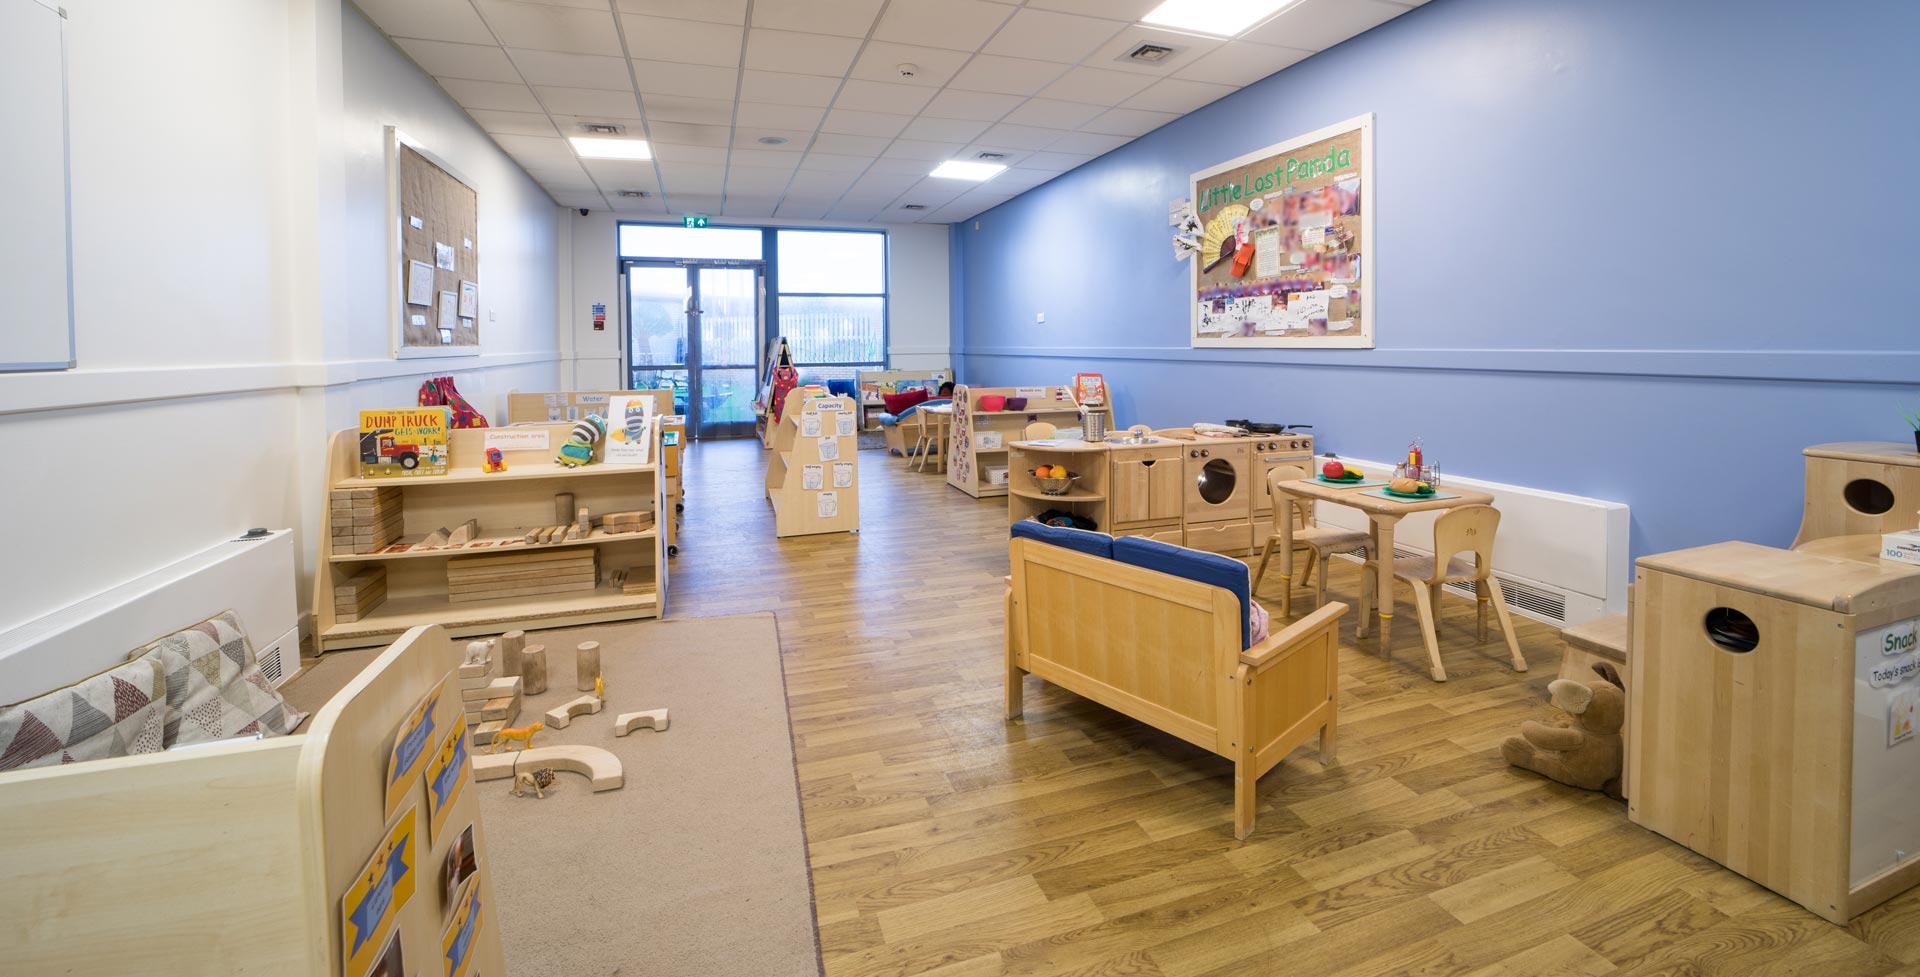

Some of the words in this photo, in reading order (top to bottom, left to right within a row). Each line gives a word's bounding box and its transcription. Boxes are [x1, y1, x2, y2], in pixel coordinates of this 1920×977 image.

[1200, 180, 1242, 212] Little
[1244, 164, 1284, 197] Lost
[1285, 143, 1351, 185] Panda
[365, 415, 397, 429] DUMP
[401, 414, 438, 428] TRUCK
[1886, 549, 1903, 558] 100
[1884, 628, 1918, 653] Snack
[1873, 666, 1899, 681] Today's
[1899, 659, 1916, 675] snack
